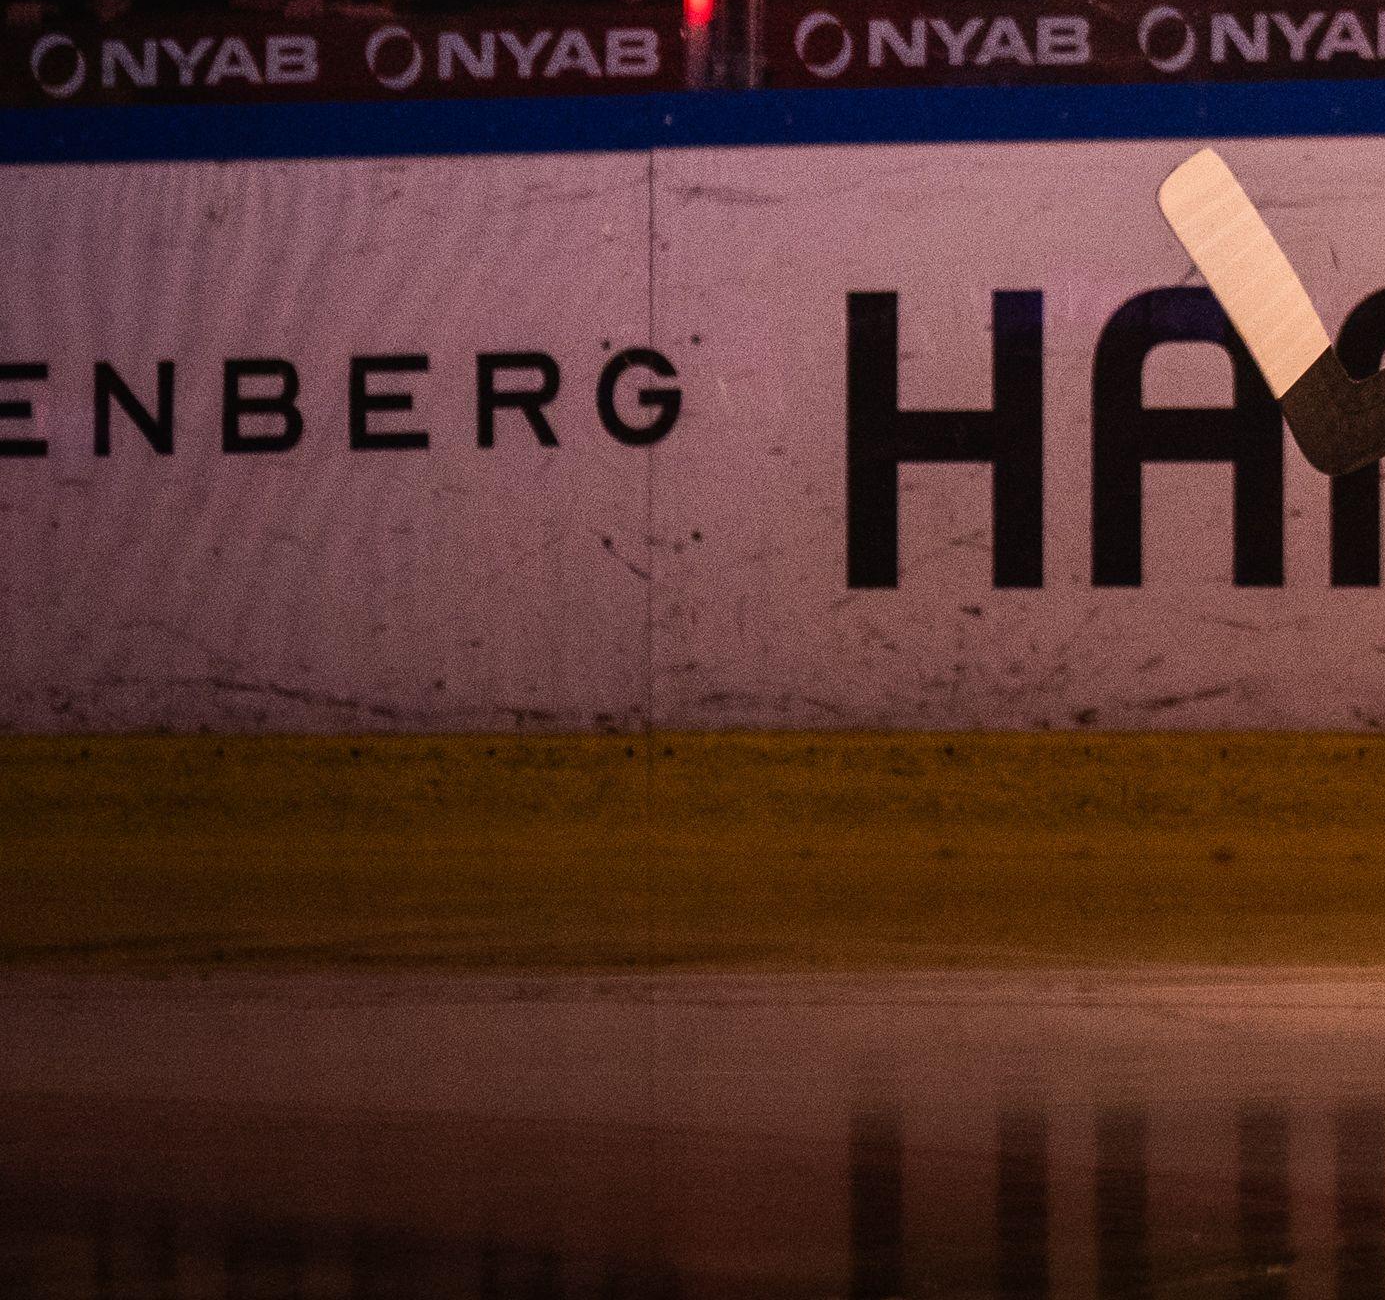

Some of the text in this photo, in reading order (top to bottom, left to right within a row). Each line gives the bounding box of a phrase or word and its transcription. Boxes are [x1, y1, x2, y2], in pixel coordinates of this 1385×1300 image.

[100, 33, 320, 87] NYAB
[437, 27, 661, 81] NYAB
[866, 15, 1093, 68] NYAB
[0, 347, 682, 457] ENBERG
